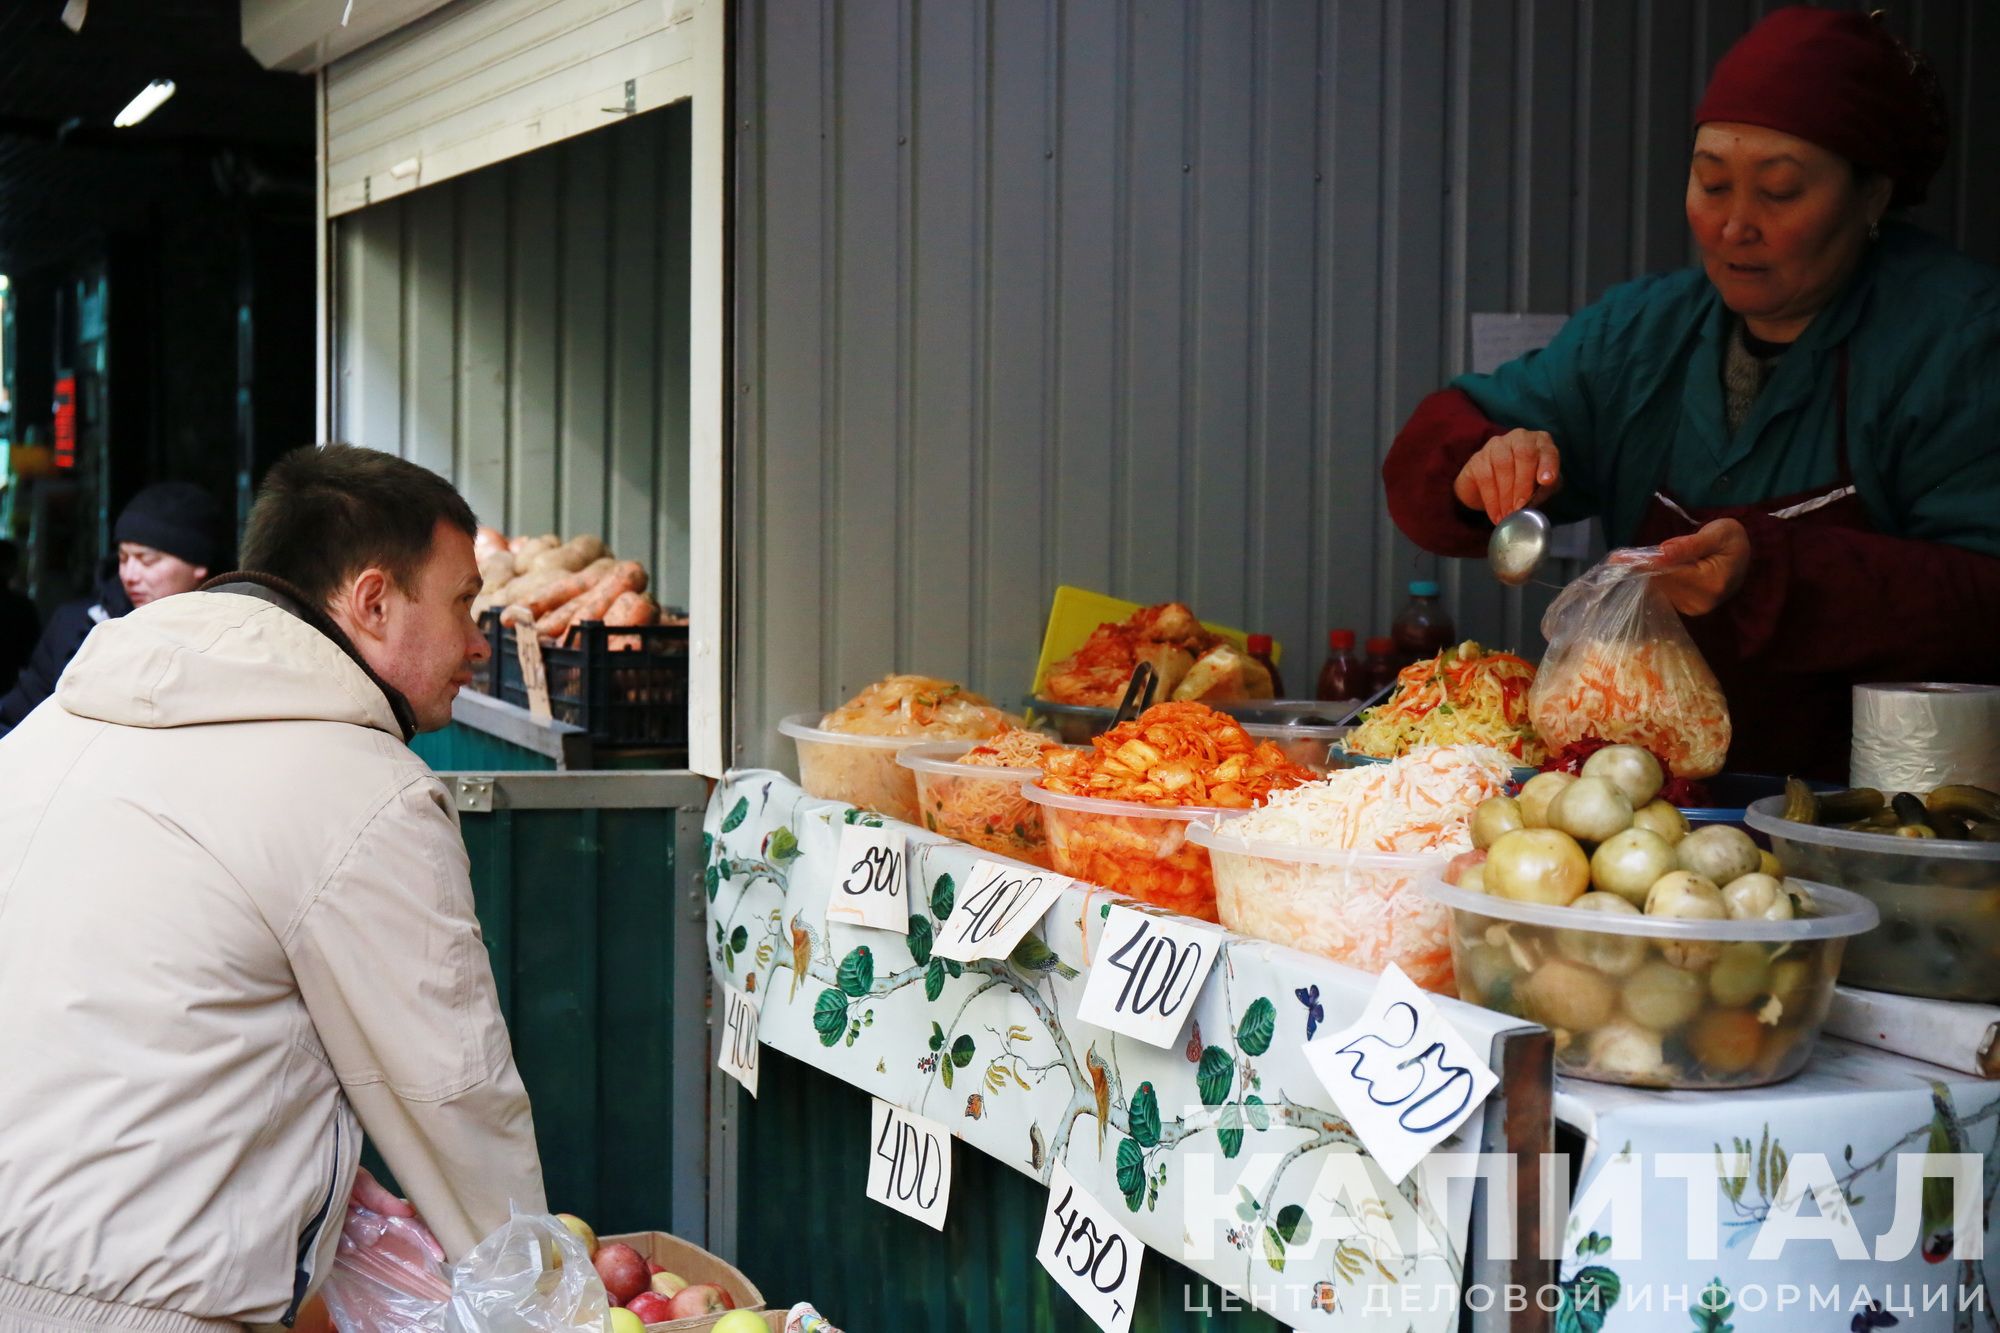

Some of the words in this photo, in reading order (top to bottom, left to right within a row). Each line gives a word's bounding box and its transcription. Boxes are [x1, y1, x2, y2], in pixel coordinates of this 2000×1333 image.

[842, 846, 902, 897] 500
[957, 870, 1043, 944] 400
[1107, 919, 1202, 1017] 400
[728, 992, 758, 1070] 400
[1335, 1001, 1473, 1133] 250
[877, 1107, 942, 1209] 400
[1053, 1185, 1128, 1294] 450
